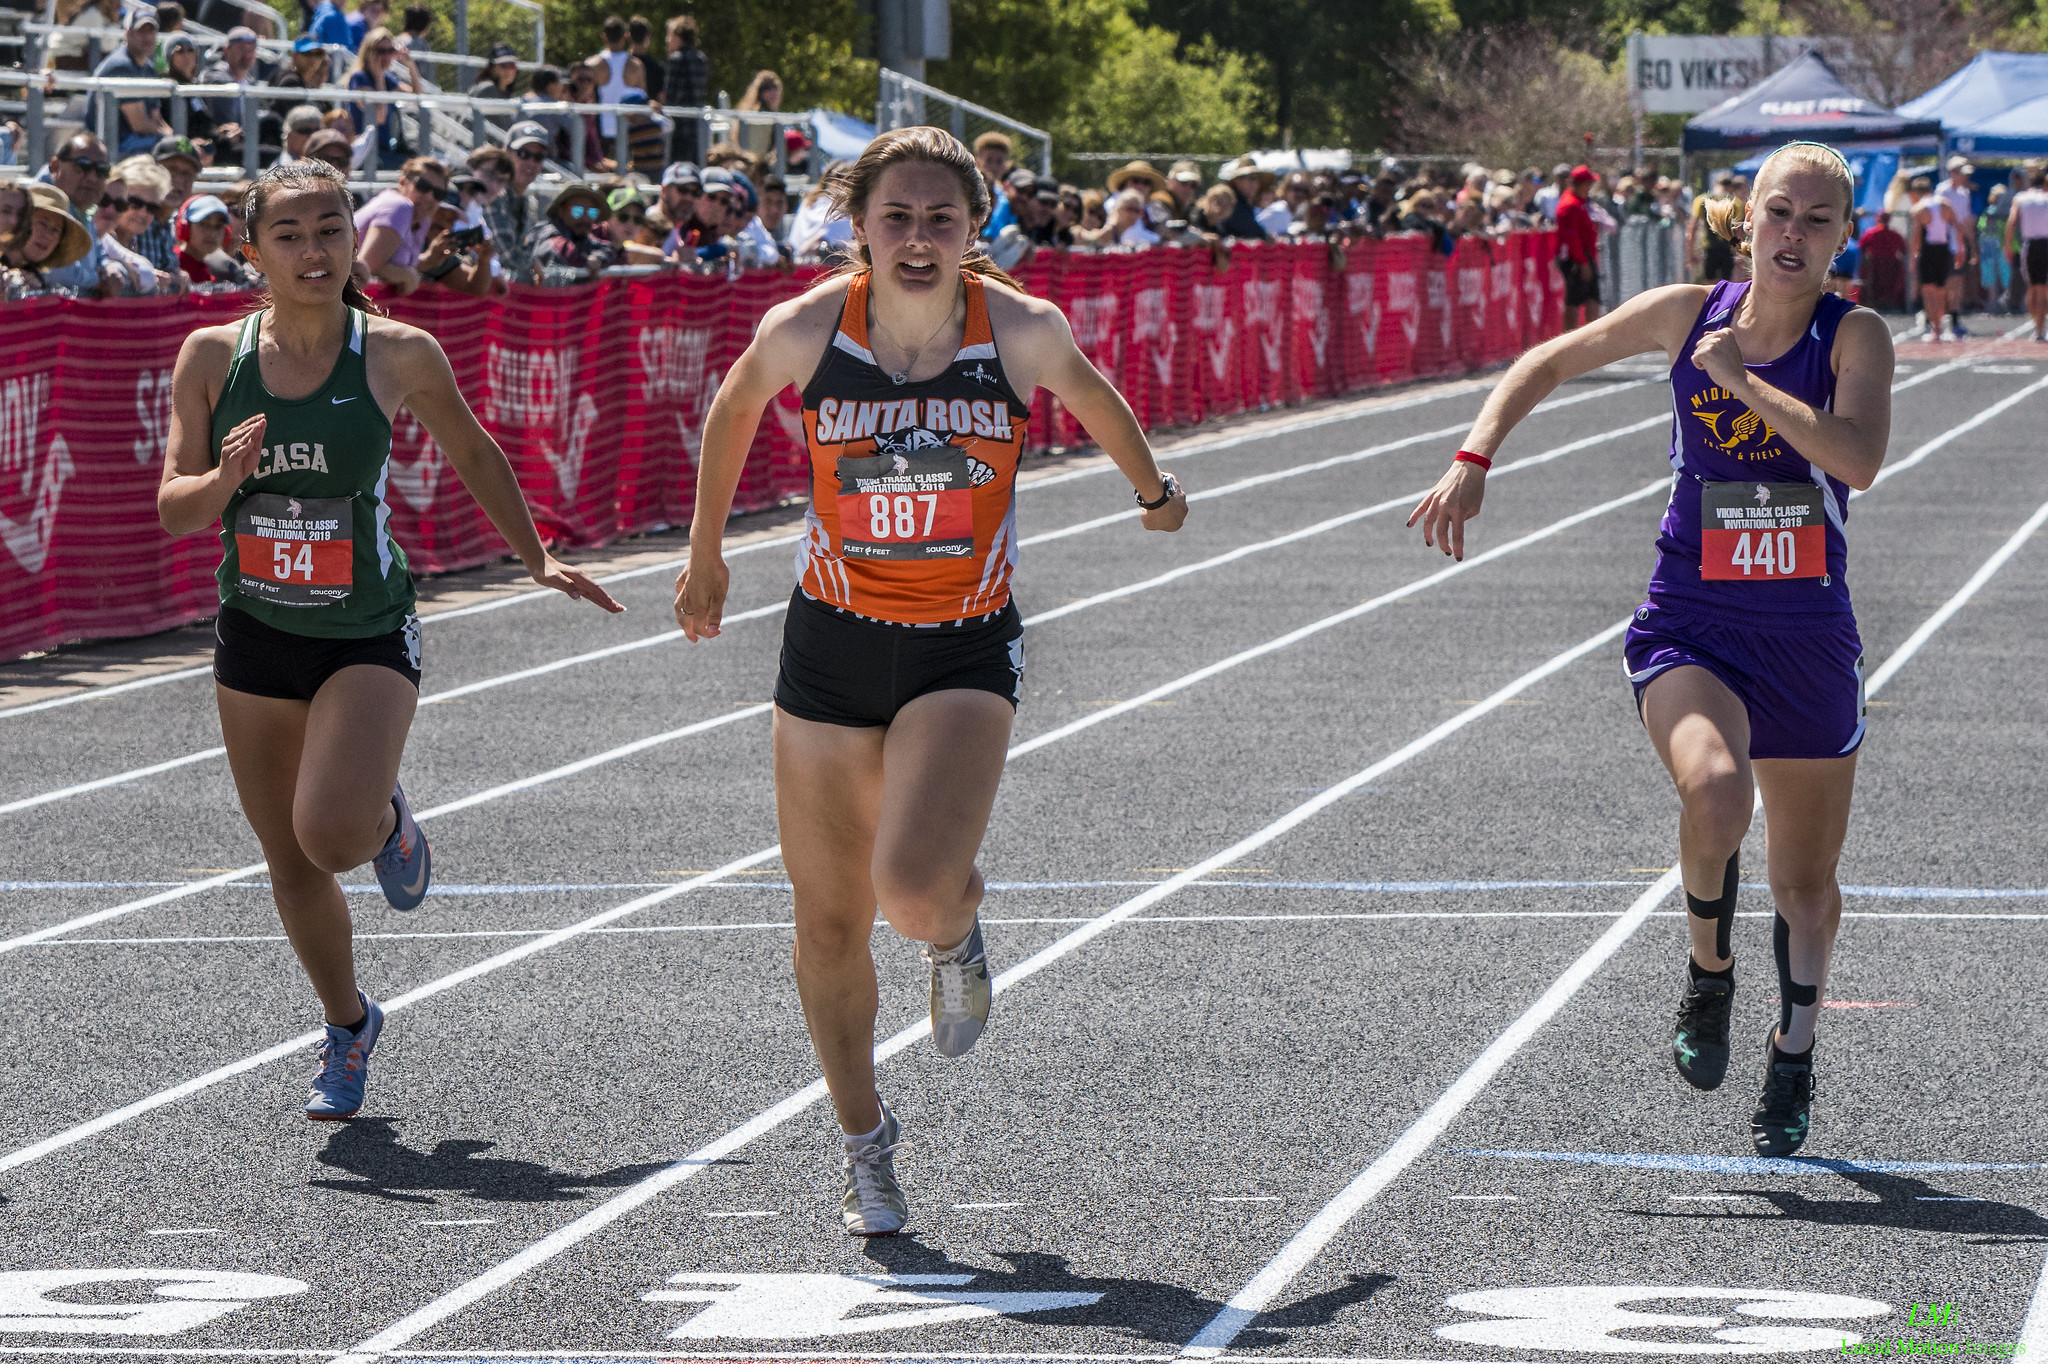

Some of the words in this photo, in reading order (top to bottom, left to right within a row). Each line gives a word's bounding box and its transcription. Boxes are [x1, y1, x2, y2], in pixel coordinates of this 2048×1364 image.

[816, 398, 920, 443] SANTA
[925, 398, 1013, 440] ROSA
[253, 442, 329, 480] CASA
[1737, 452, 1744, 460] &
[1750, 448, 1782, 461] FIELD
[882, 475, 912, 484] TRACK
[914, 472, 953, 483] CLASSIC
[860, 483, 919, 494] INVITATIONAL
[920, 482, 946, 492] 2019
[869, 493, 938, 539] 887
[1716, 507, 1744, 519] VIKING
[1745, 506, 1773, 518] TRACK
[1774, 505, 1810, 517] CLASSIC
[250, 515, 276, 528] VIKING
[277, 519, 304, 530] TRACK
[305, 519, 339, 531] CLASSIC
[1724, 518, 1778, 530] INVITATIONAL
[1780, 516, 1802, 529] 2019
[256, 526, 307, 541] INVITATIONAL
[309, 531, 331, 541] 2019
[843, 544, 865, 554] FLEET
[872, 548, 891, 556] FEET
[925, 544, 961, 554] saucony
[1731, 530, 1796, 576] 440
[273, 541, 314, 581] 54
[241, 578, 260, 588] FLEET
[265, 585, 281, 593] FEET
[310, 589, 342, 597] saucony
[640, 1272, 1107, 1340] 4
[1432, 1284, 1893, 1355] 3
